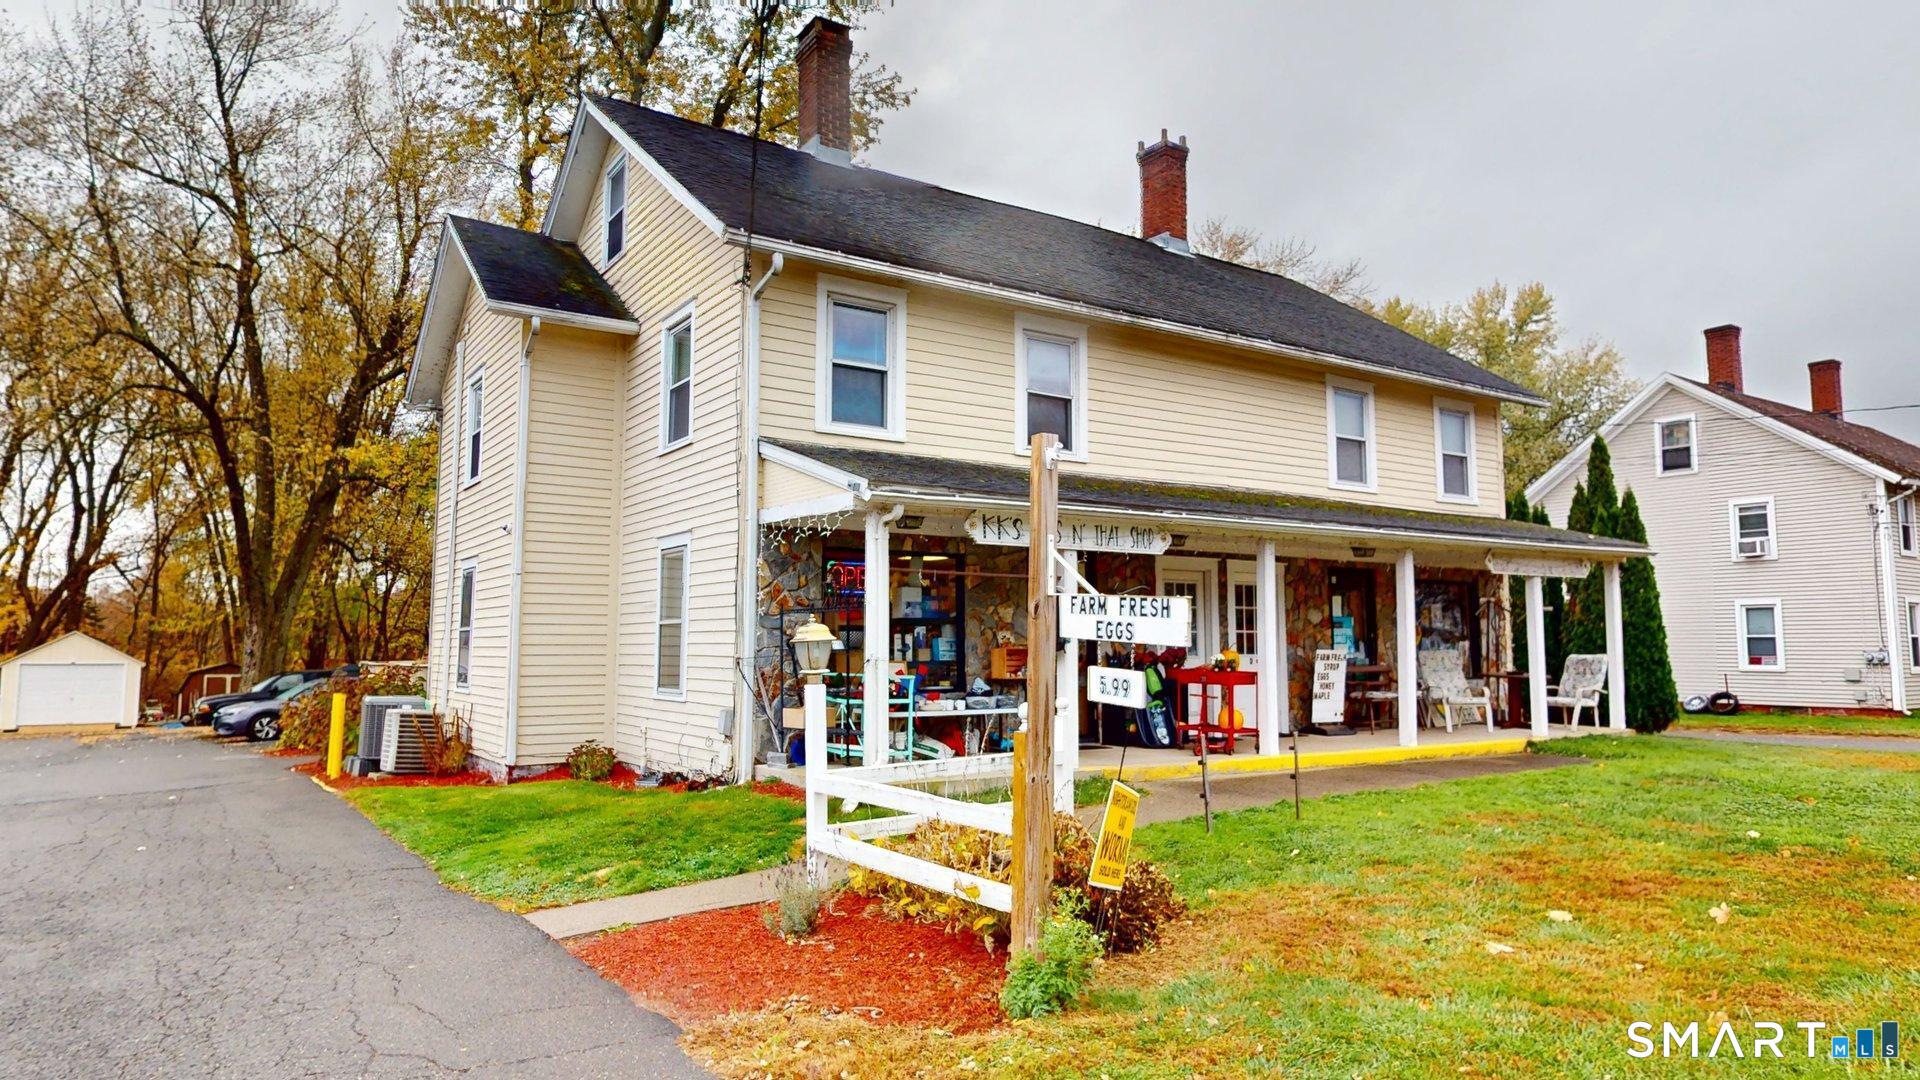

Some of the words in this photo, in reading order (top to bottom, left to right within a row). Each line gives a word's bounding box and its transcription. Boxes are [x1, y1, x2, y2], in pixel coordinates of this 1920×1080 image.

[982, 513, 1023, 540] KK'S
[1094, 524, 1119, 547] THAT
[1130, 526, 1154, 549] SHOP
[831, 565, 866, 589] OPE
[1070, 595, 1107, 615] FARM
[1119, 597, 1171, 618] FRESH
[1096, 620, 1134, 641] EGGS
[1316, 653, 1330, 661] FARM
[1323, 662, 1339, 671] SYRUP
[1099, 675, 1131, 698] 5.99
[1320, 682, 1335, 690] HONEY
[1313, 692, 1330, 700] MAPLE
[1099, 866, 1110, 877] SOLD
